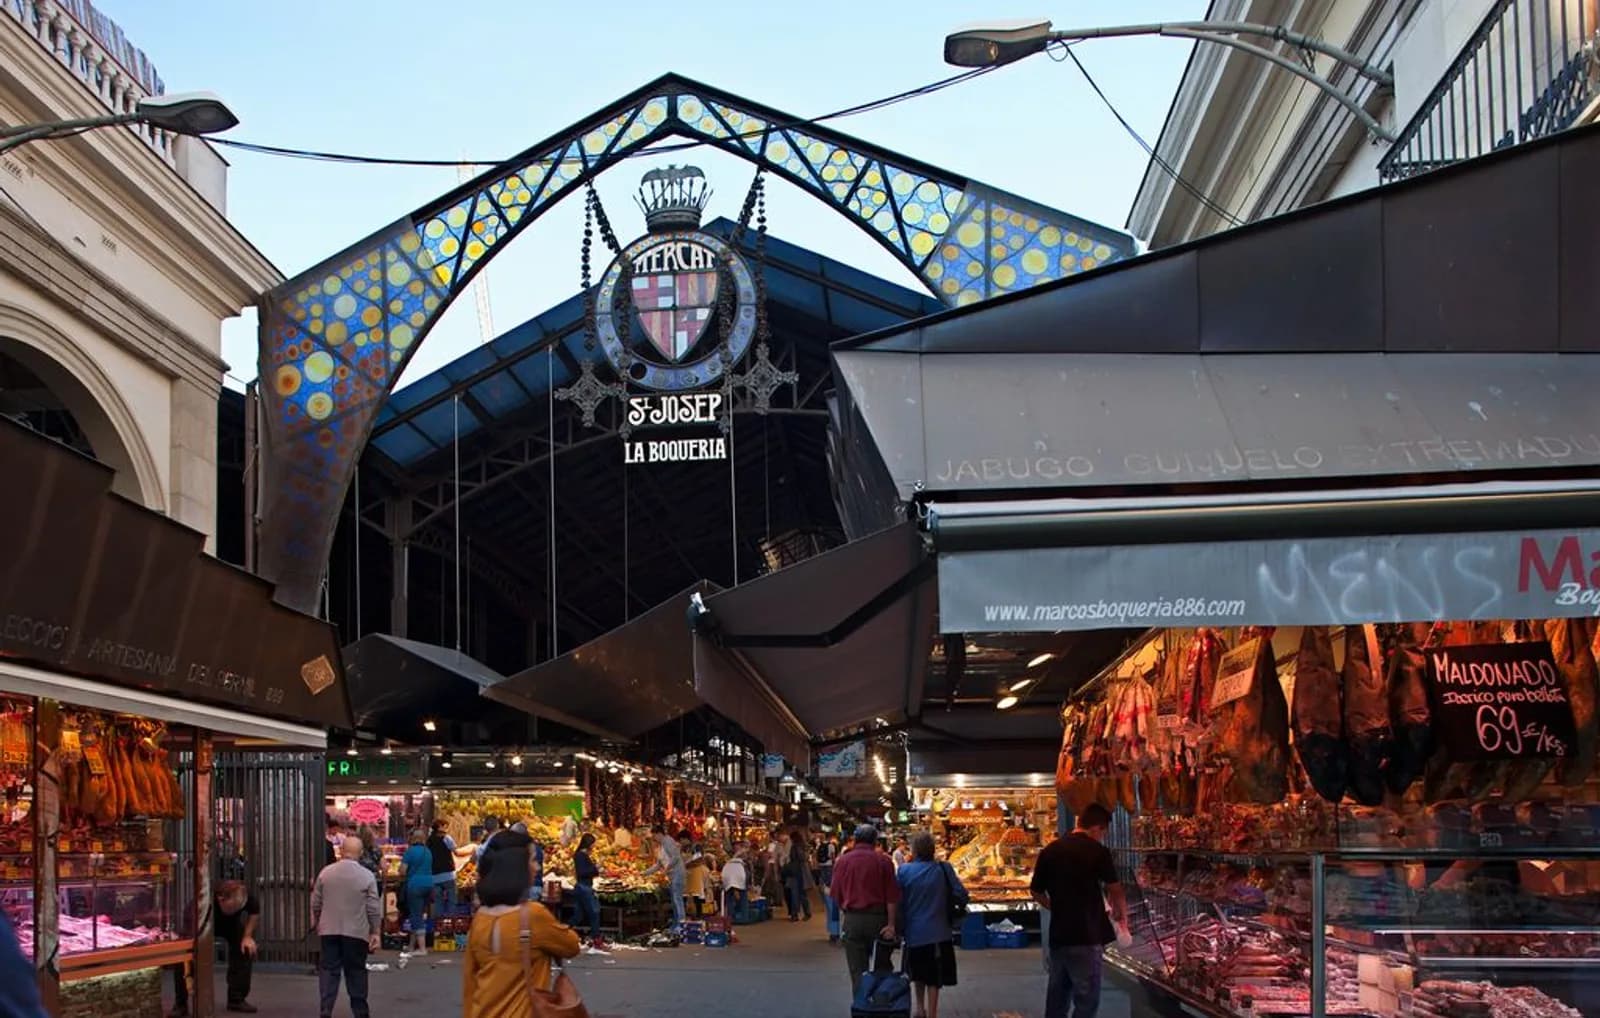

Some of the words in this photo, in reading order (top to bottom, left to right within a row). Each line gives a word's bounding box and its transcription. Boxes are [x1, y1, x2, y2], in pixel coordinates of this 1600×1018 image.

[632, 240, 716, 274] MERCAT
[650, 393, 722, 424] JOSEP
[624, 442, 645, 463] LA
[648, 438, 727, 462] BOQUERIA
[937, 455, 1093, 481] JABUGO
[1433, 652, 1556, 686] MALDONADO
[1476, 705, 1522, 754] 69
